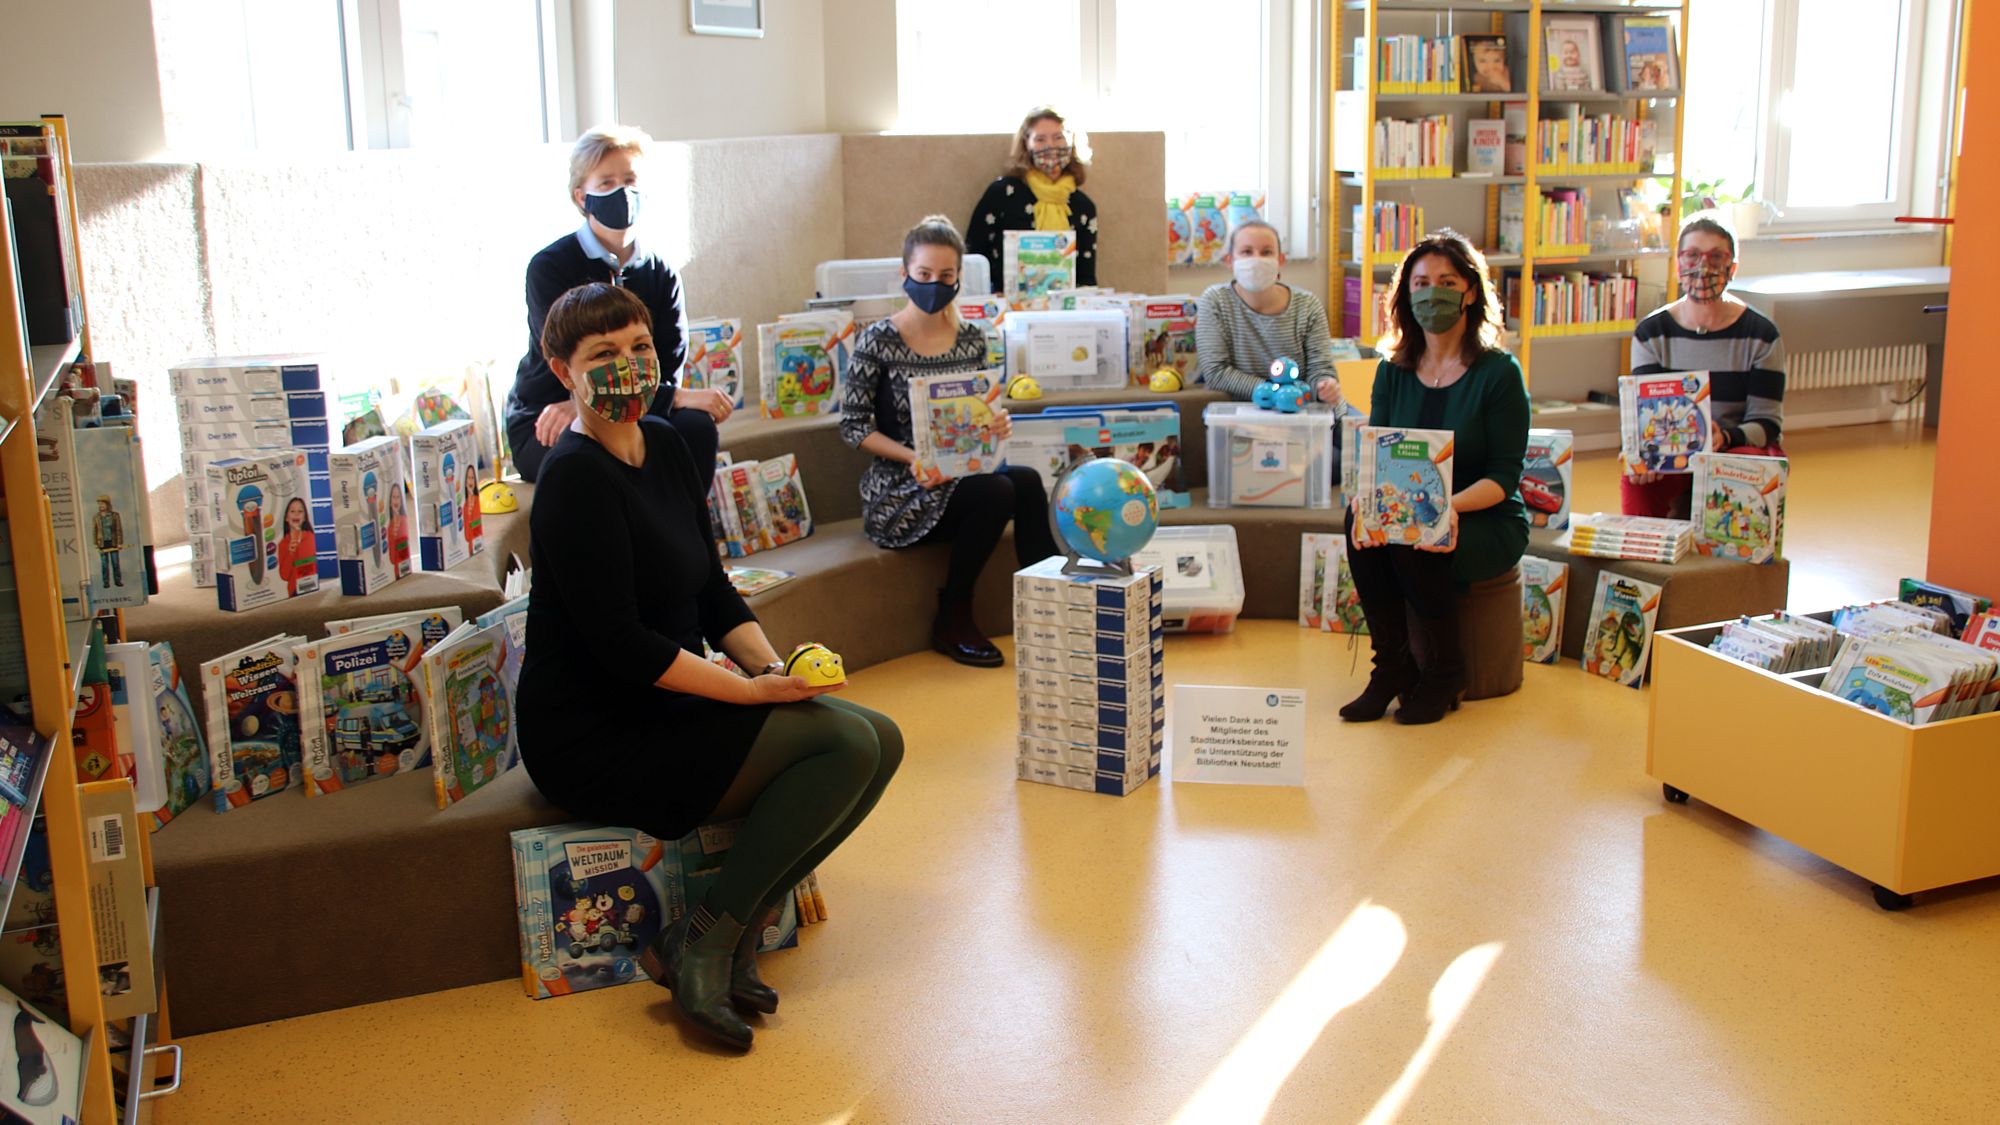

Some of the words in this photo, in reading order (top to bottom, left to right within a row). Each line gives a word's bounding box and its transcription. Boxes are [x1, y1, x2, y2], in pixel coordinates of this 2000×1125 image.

[222, 432, 238, 440] Stift
[228, 464, 258, 483] tiptoi
[335, 653, 378, 671] Polizei
[238, 666, 278, 686] Wissen
[230, 682, 277, 700] Weltraum
[1230, 716, 1250, 724] Dank
[1210, 726, 1252, 736] Mitglieder
[1254, 728, 1269, 736] des
[1190, 736, 1274, 746] Stadtbezirksbeirates
[1276, 739, 1288, 747] für
[1209, 748, 1268, 758] Unterstützung
[1270, 750, 1284, 758] der
[1196, 758, 1239, 768] Bibliothek
[1240, 760, 1282, 769] Neustadt!
[570, 848, 629, 867] WELTRAUM-
[584, 862, 619, 876] MISSION
[538, 935, 550, 962] tiptoi
